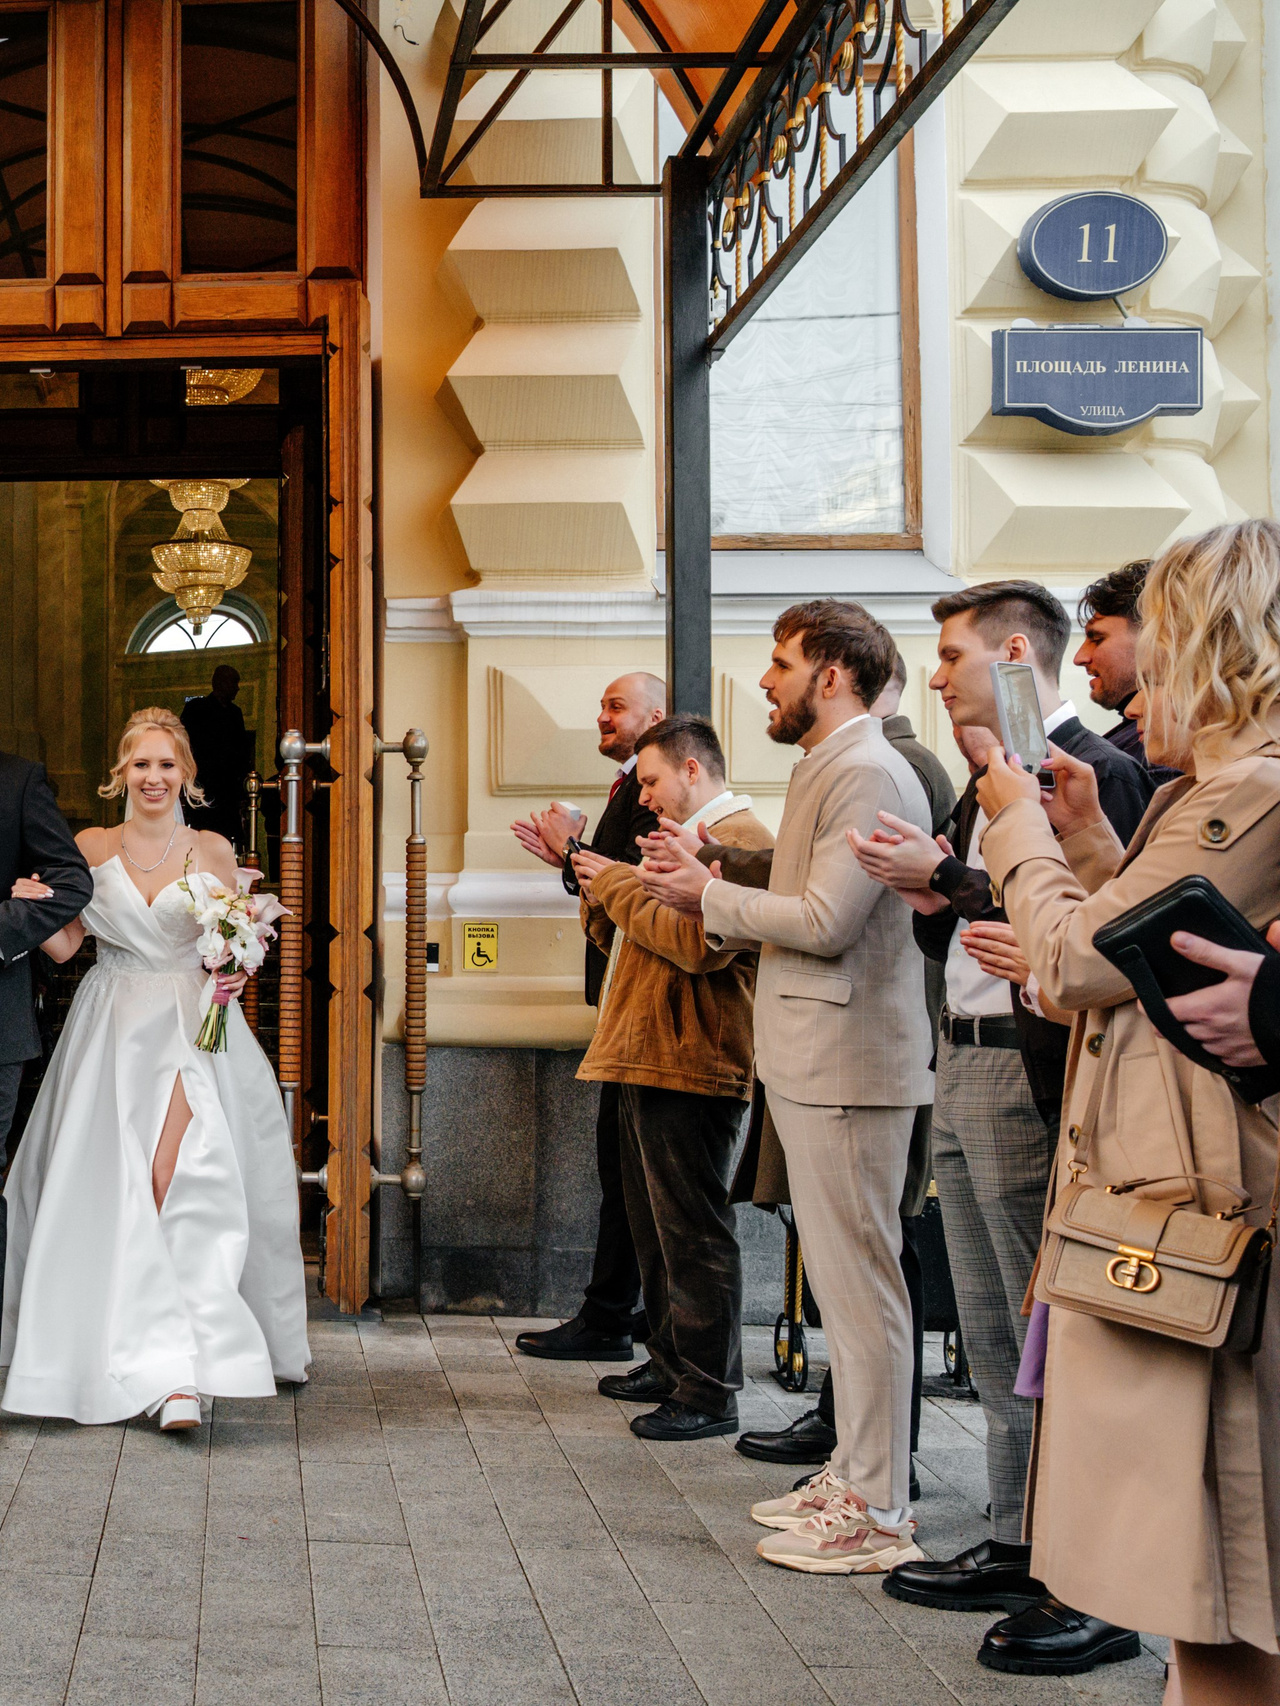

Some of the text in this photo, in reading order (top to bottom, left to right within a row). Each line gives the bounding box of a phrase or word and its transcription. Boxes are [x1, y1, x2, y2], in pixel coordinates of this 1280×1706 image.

[1077, 223, 1119, 263] 11
[1015, 360, 1190, 375] ПЛОЩАДЬ ЛЕНИНА
[1080, 405, 1126, 417] УЛИЦА
